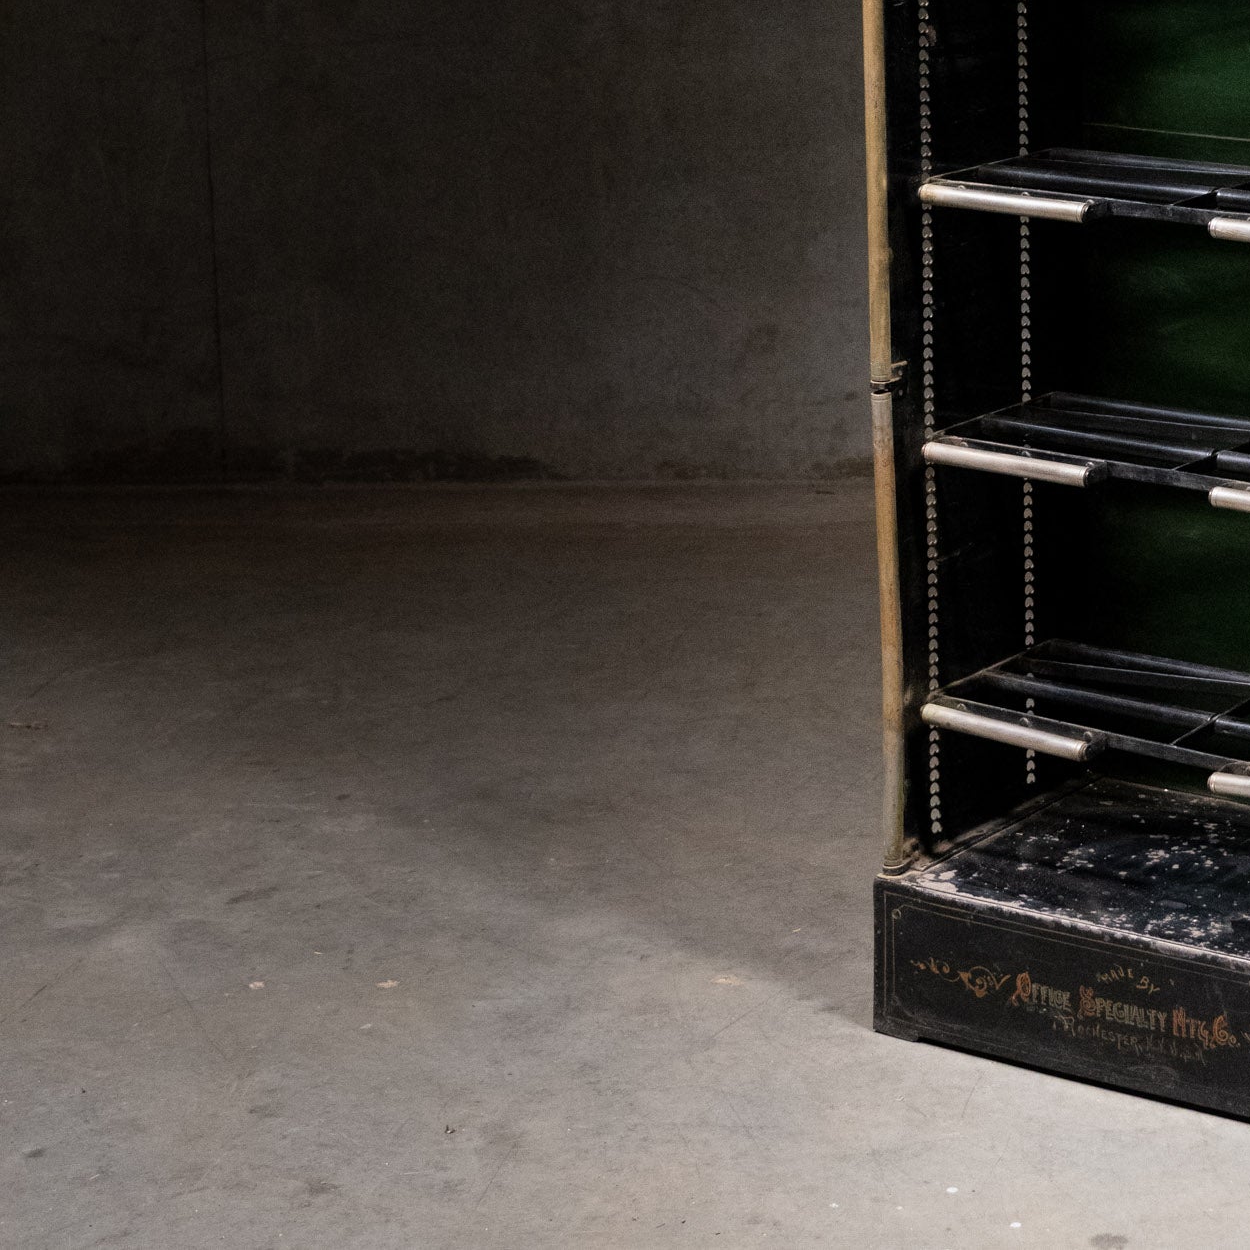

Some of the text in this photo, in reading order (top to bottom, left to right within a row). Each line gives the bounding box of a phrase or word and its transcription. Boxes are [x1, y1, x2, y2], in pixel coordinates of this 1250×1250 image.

[1010, 971, 1070, 1008] OFFICE
[1077, 985, 1167, 1032] SPECIALTY
[1098, 965, 1160, 994] MADE BY
